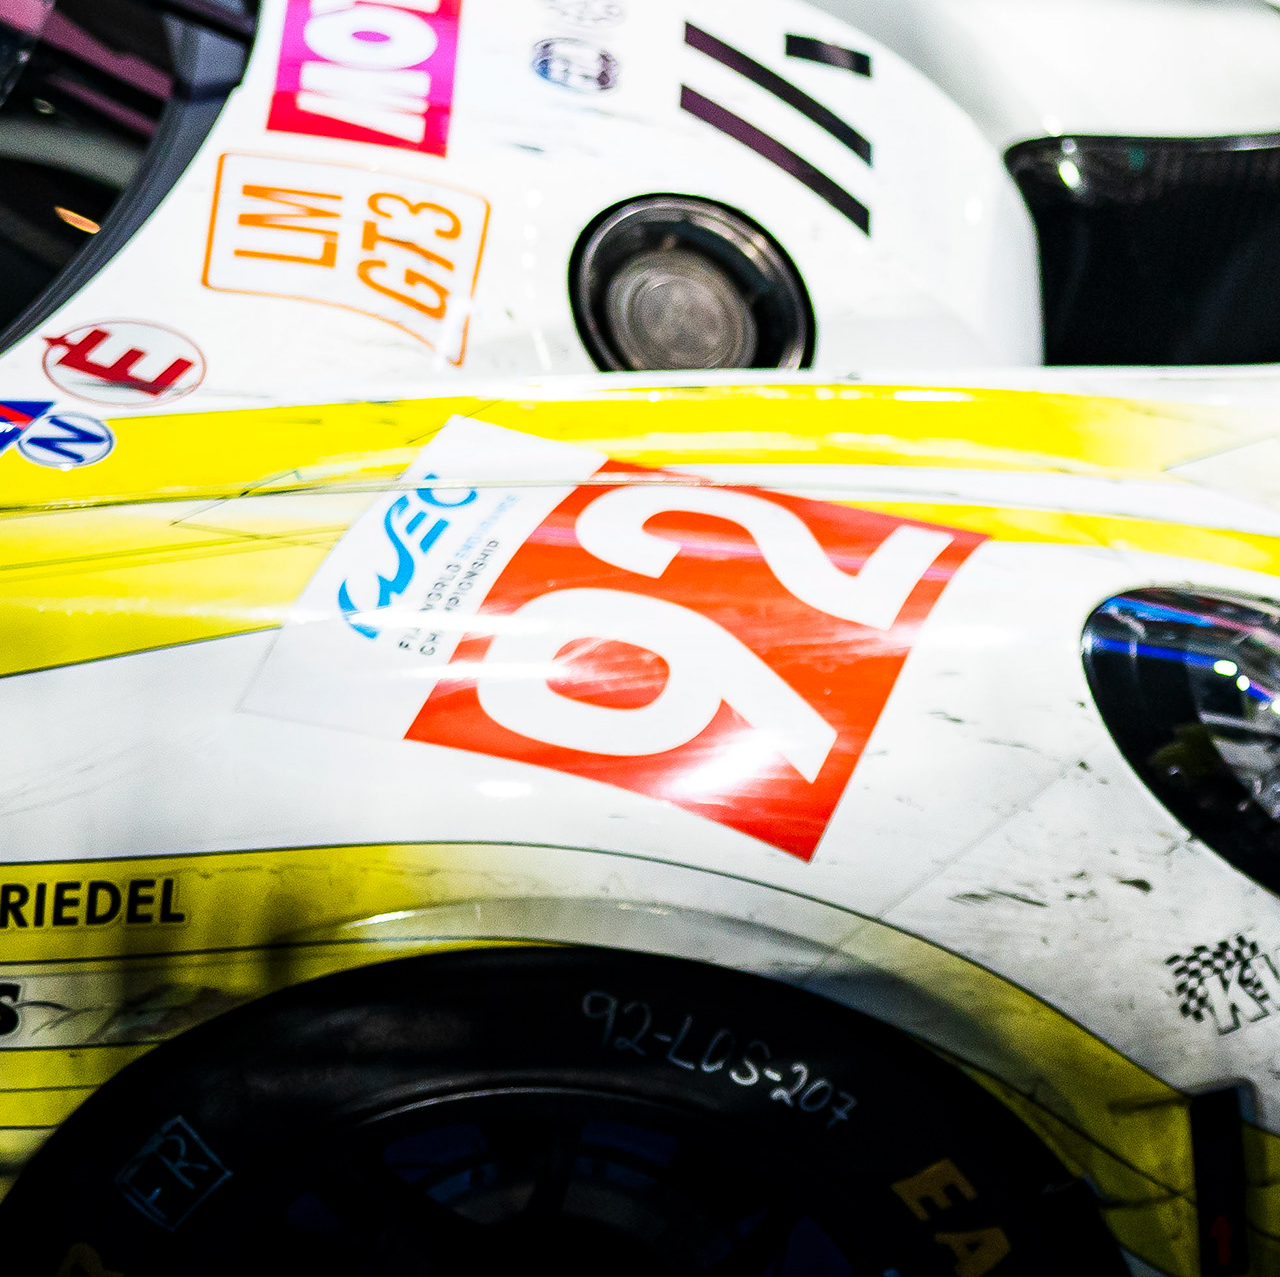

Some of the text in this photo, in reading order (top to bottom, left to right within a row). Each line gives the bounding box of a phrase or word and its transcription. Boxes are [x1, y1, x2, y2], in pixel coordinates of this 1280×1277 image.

[233, 184, 344, 269] LM
[357, 191, 463, 322] GT3
[476, 484, 956, 784] 92
[0, 878, 186, 930] RIEDEL
